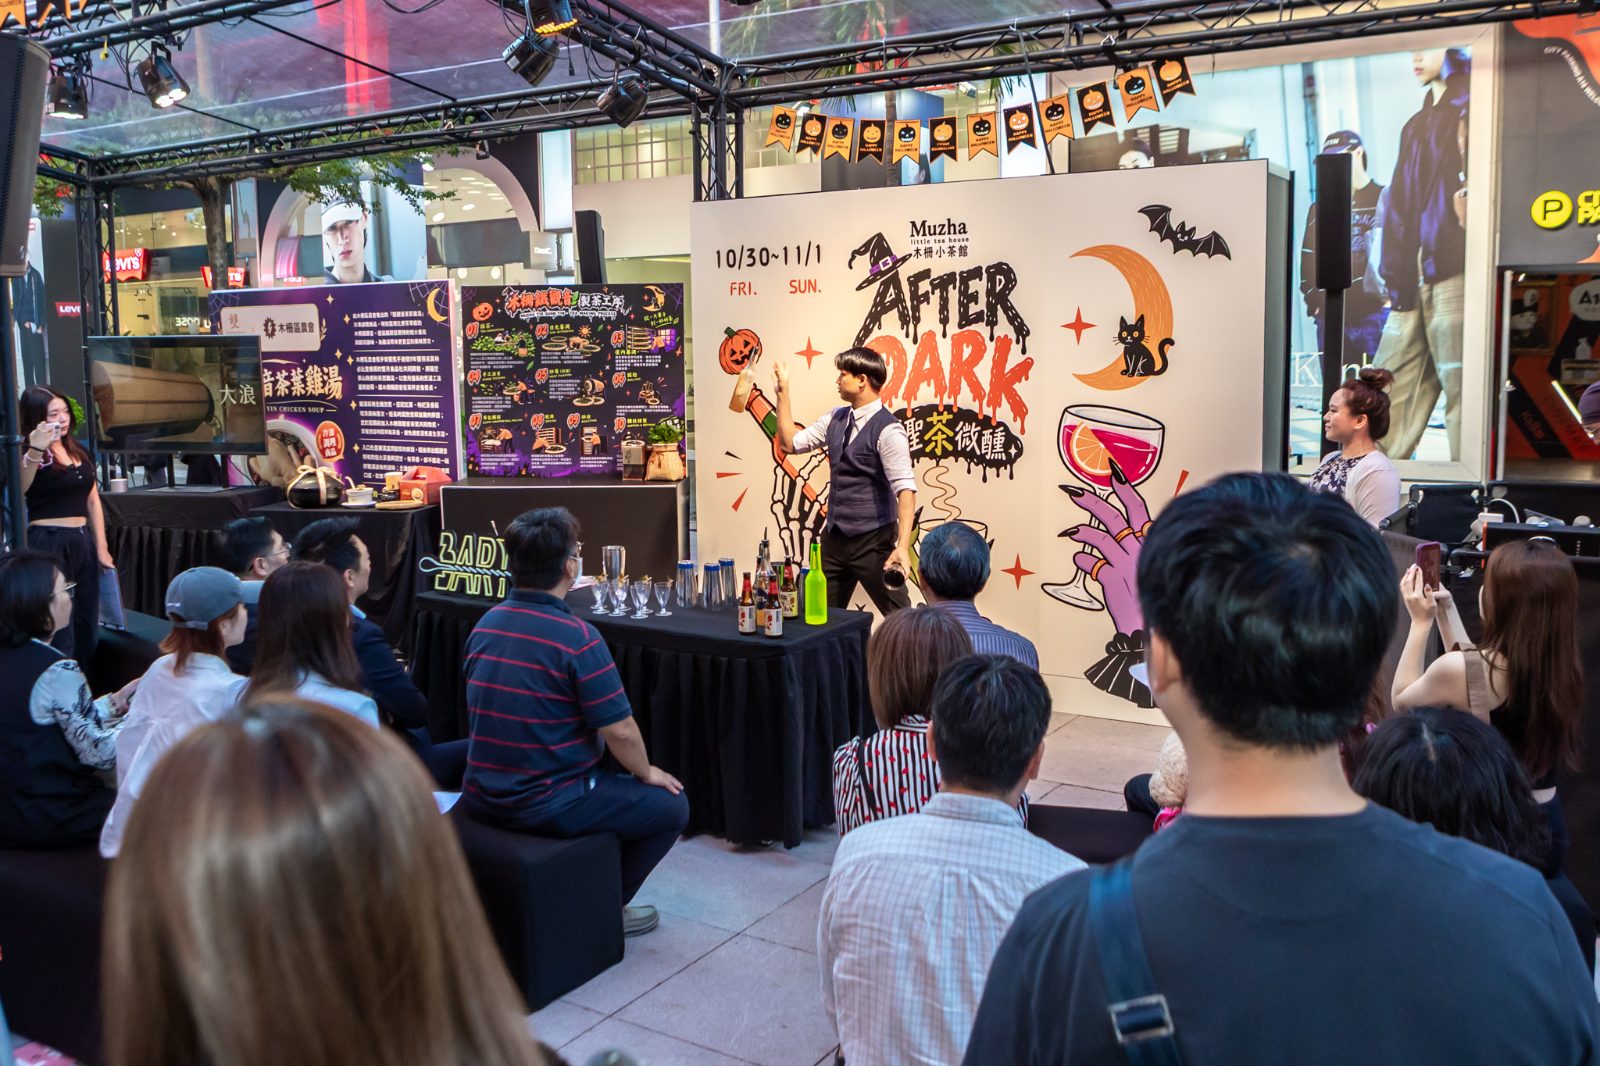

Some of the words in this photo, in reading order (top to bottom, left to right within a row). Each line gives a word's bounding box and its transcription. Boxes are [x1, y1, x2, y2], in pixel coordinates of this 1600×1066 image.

[1577, 190, 1600, 207] CI
[1543, 199, 1564, 221] P
[910, 218, 968, 238] Muzha
[913, 245, 969, 259] 木柵小茶館
[730, 281, 758, 296] FRI.
[789, 279, 822, 294] SUN.
[507, 288, 572, 311] 木柵鐵觀音
[853, 261, 1031, 355] AFTER
[278, 322, 315, 333] 木柵區農會
[864, 329, 1035, 435] DARK
[219, 384, 257, 405] 大浪
[898, 411, 1007, 461] 聖茶微醺
